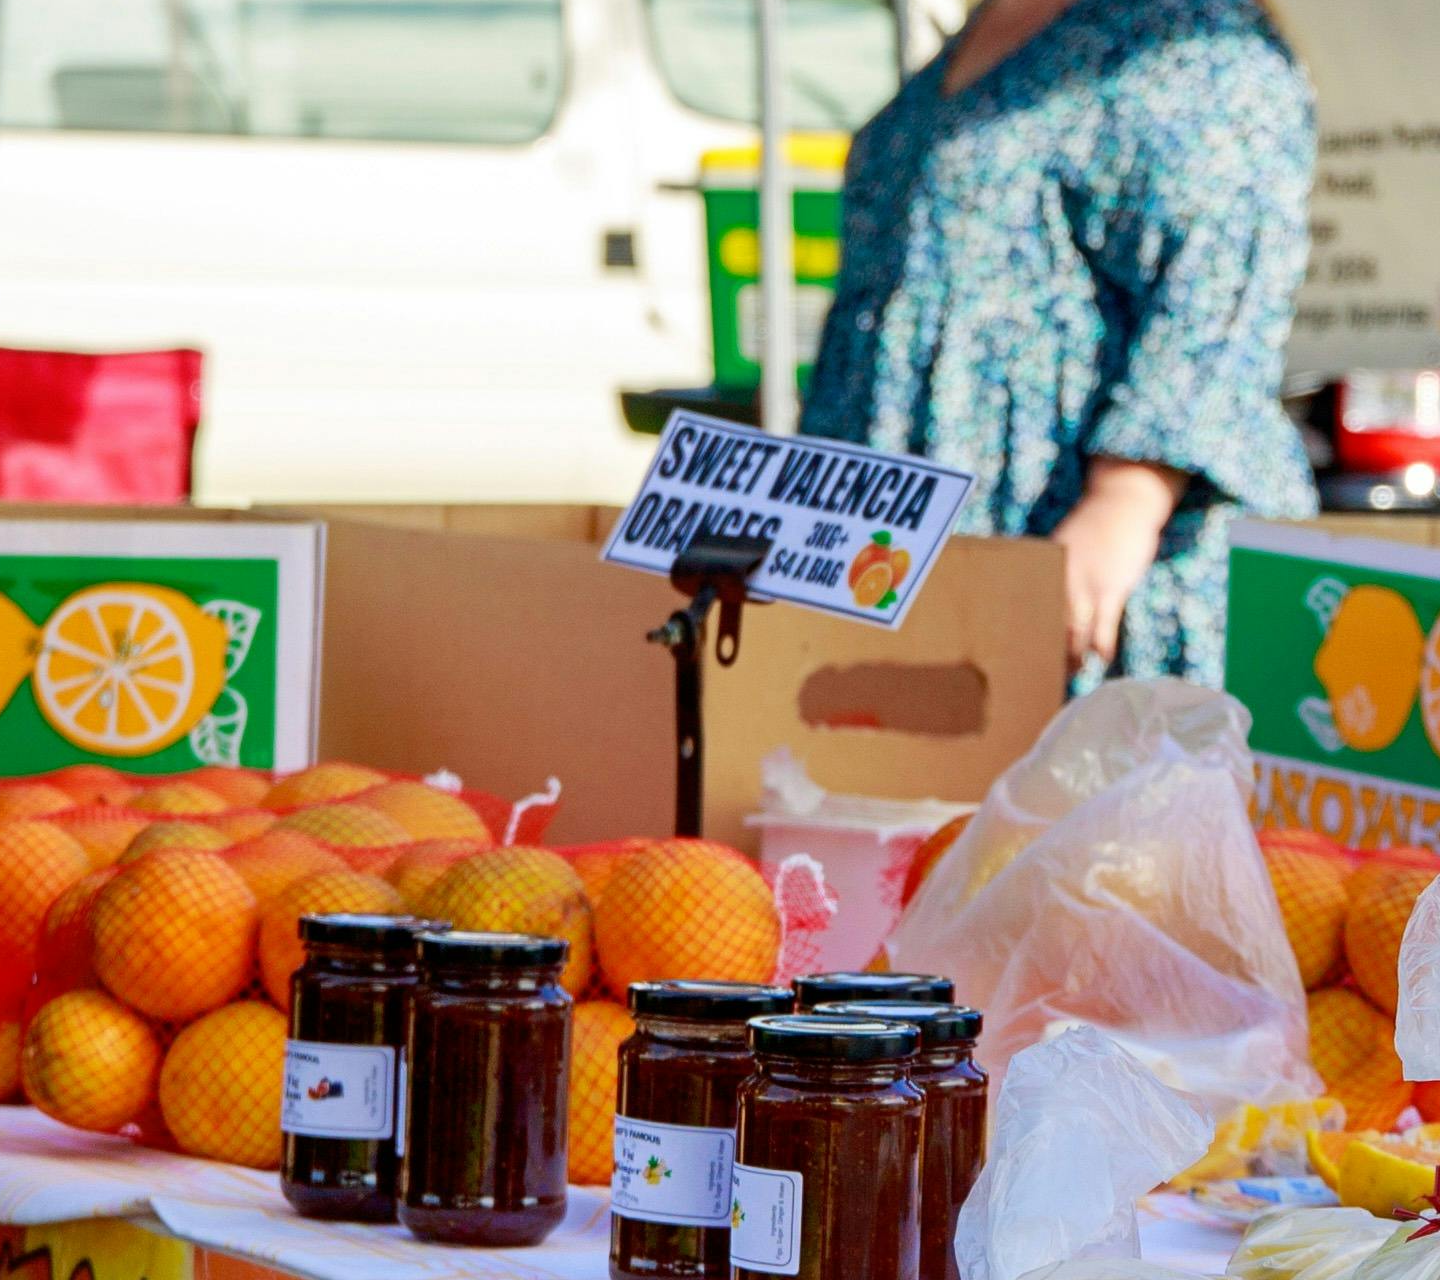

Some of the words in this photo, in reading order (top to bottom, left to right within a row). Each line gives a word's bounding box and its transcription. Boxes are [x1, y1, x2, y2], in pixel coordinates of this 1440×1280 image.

[658, 425, 783, 496] SWEET
[767, 446, 939, 531] VALENCIA
[768, 547, 799, 578] $4
[791, 553, 811, 581] A
[804, 556, 846, 589] BAG
